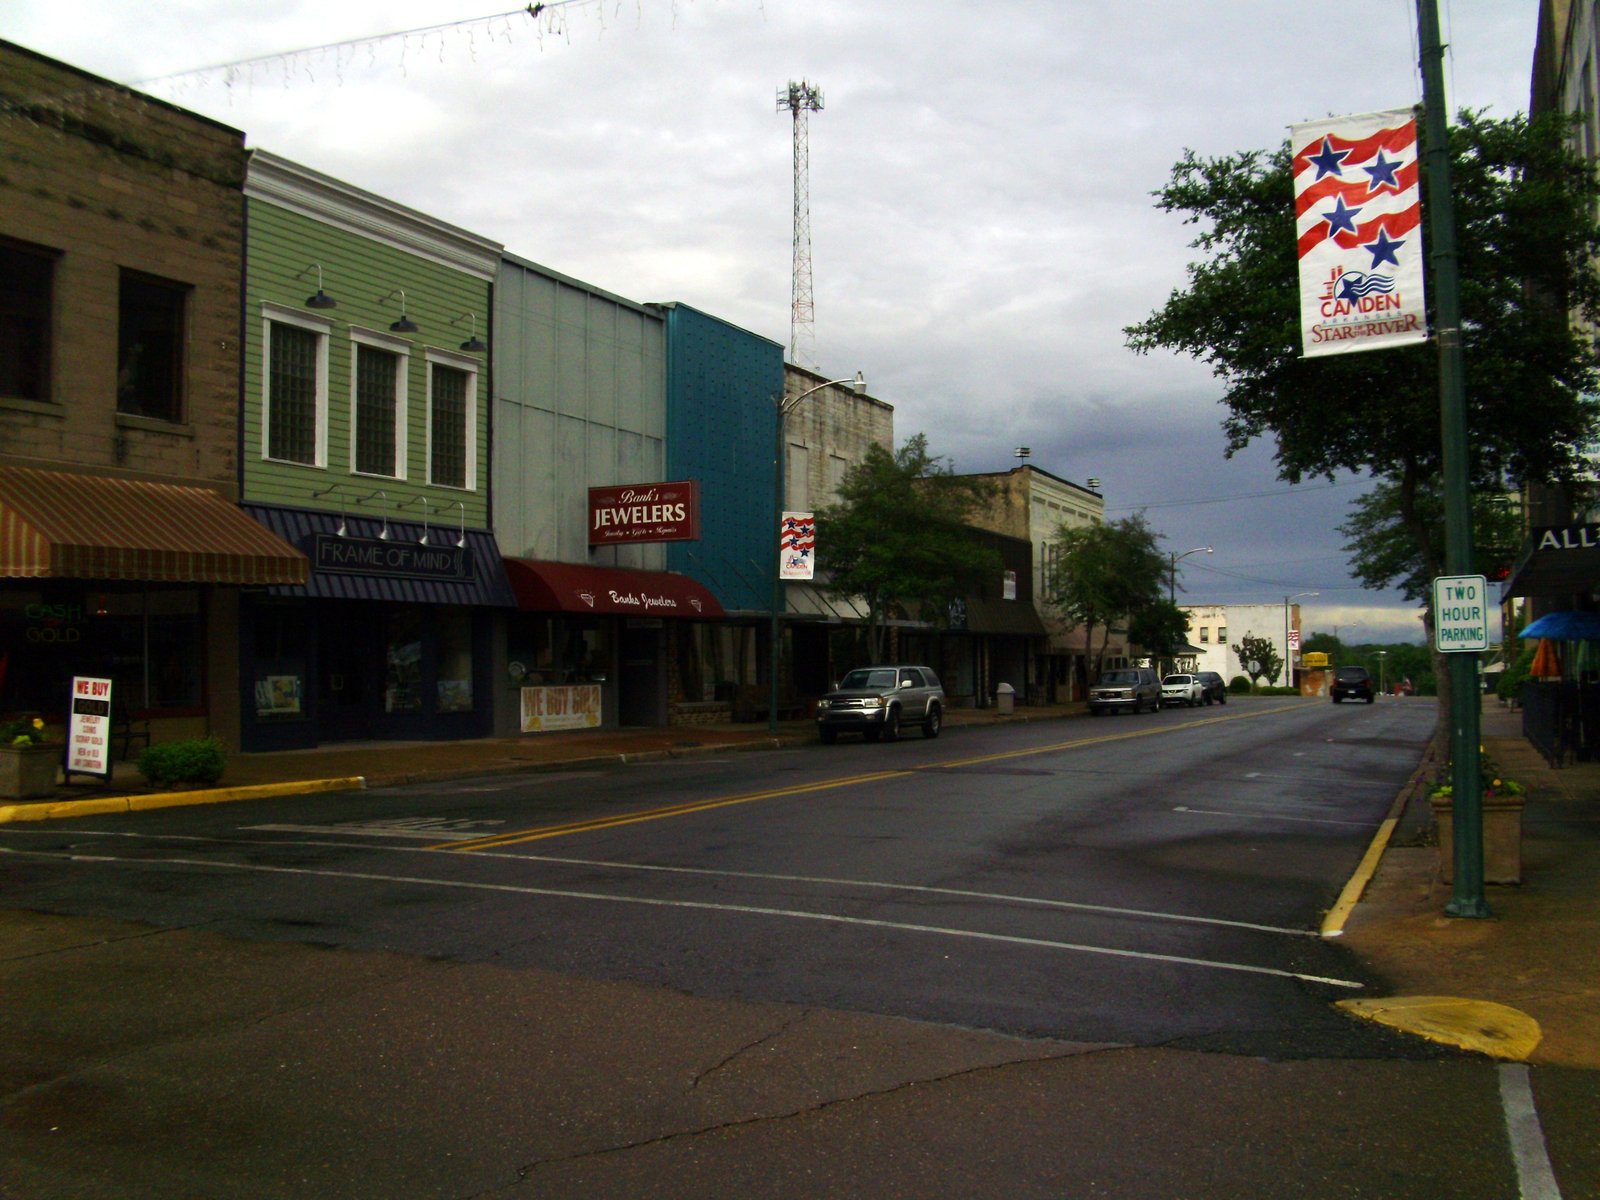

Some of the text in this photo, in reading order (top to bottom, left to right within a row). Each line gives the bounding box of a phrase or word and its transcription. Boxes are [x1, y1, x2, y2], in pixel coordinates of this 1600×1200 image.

[1321, 293, 1401, 318] CAMDEN
[1322, 310, 1402, 325] ARKANSAS
[1312, 324, 1354, 343] STAR
[1366, 313, 1422, 337] RIVER
[618, 488, 659, 504] Bank's
[594, 503, 686, 530] JEWELERS
[1538, 527, 1600, 551] ALL
[321, 542, 451, 570] FRAME OF MIND
[608, 589, 677, 610] Banks Jewelers
[1445, 586, 1475, 601] TWO
[25, 603, 82, 621] CASH
[1442, 607, 1481, 621] HOUR
[26, 628, 80, 642] GOLD
[1441, 627, 1484, 642] PARKING
[77, 681, 110, 697] WE BUY
[523, 685, 600, 716] WE BUY GOLD
